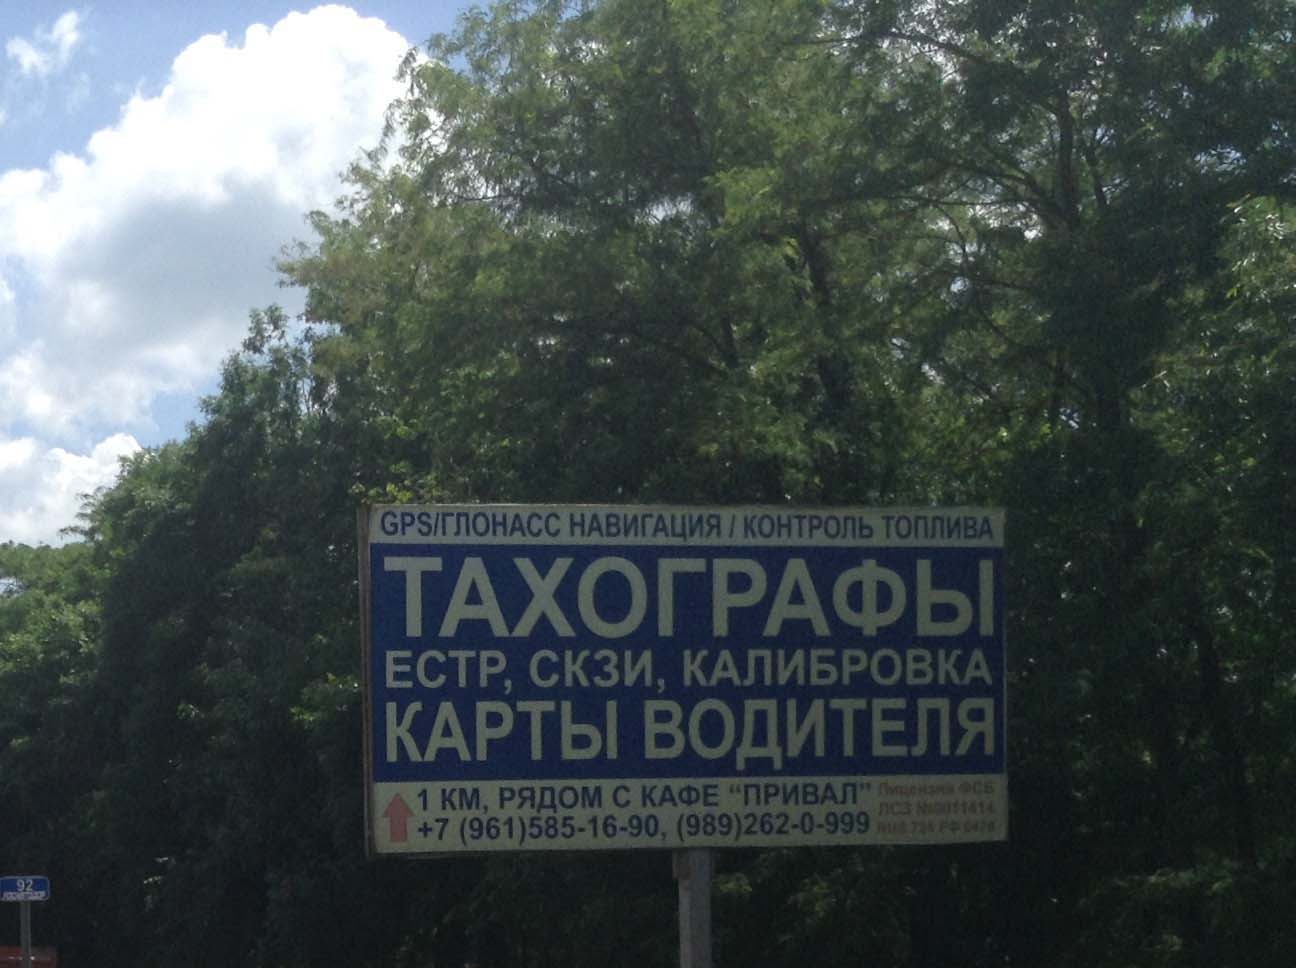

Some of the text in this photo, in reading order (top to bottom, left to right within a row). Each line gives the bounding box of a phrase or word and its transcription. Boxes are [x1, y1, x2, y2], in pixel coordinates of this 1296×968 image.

[380, 511, 994, 542] GPS/ГЛОНАСС НАВИГАЦИЯ / КОНТРОЛЬ ТОПЛИВА
[384, 556, 995, 639] ТАХОГРАФЫ
[385, 648, 993, 695] ЕСТР, СКЗИ, КАЛИБРОВКА
[385, 698, 995, 770] КАРТЫ ВОДИТЕЛЯ
[416, 789, 429, 812] 1
[440, 788, 489, 814] КМ,
[498, 786, 603, 813] РЯДОМ
[611, 785, 632, 808] С
[641, 784, 720, 807] КАФЕ
[417, 818, 449, 840] +7
[460, 814, 668, 846] (961)585-16-90,
[676, 811, 871, 842] (989)262-0-999
[16, 878, 33, 892] 92
